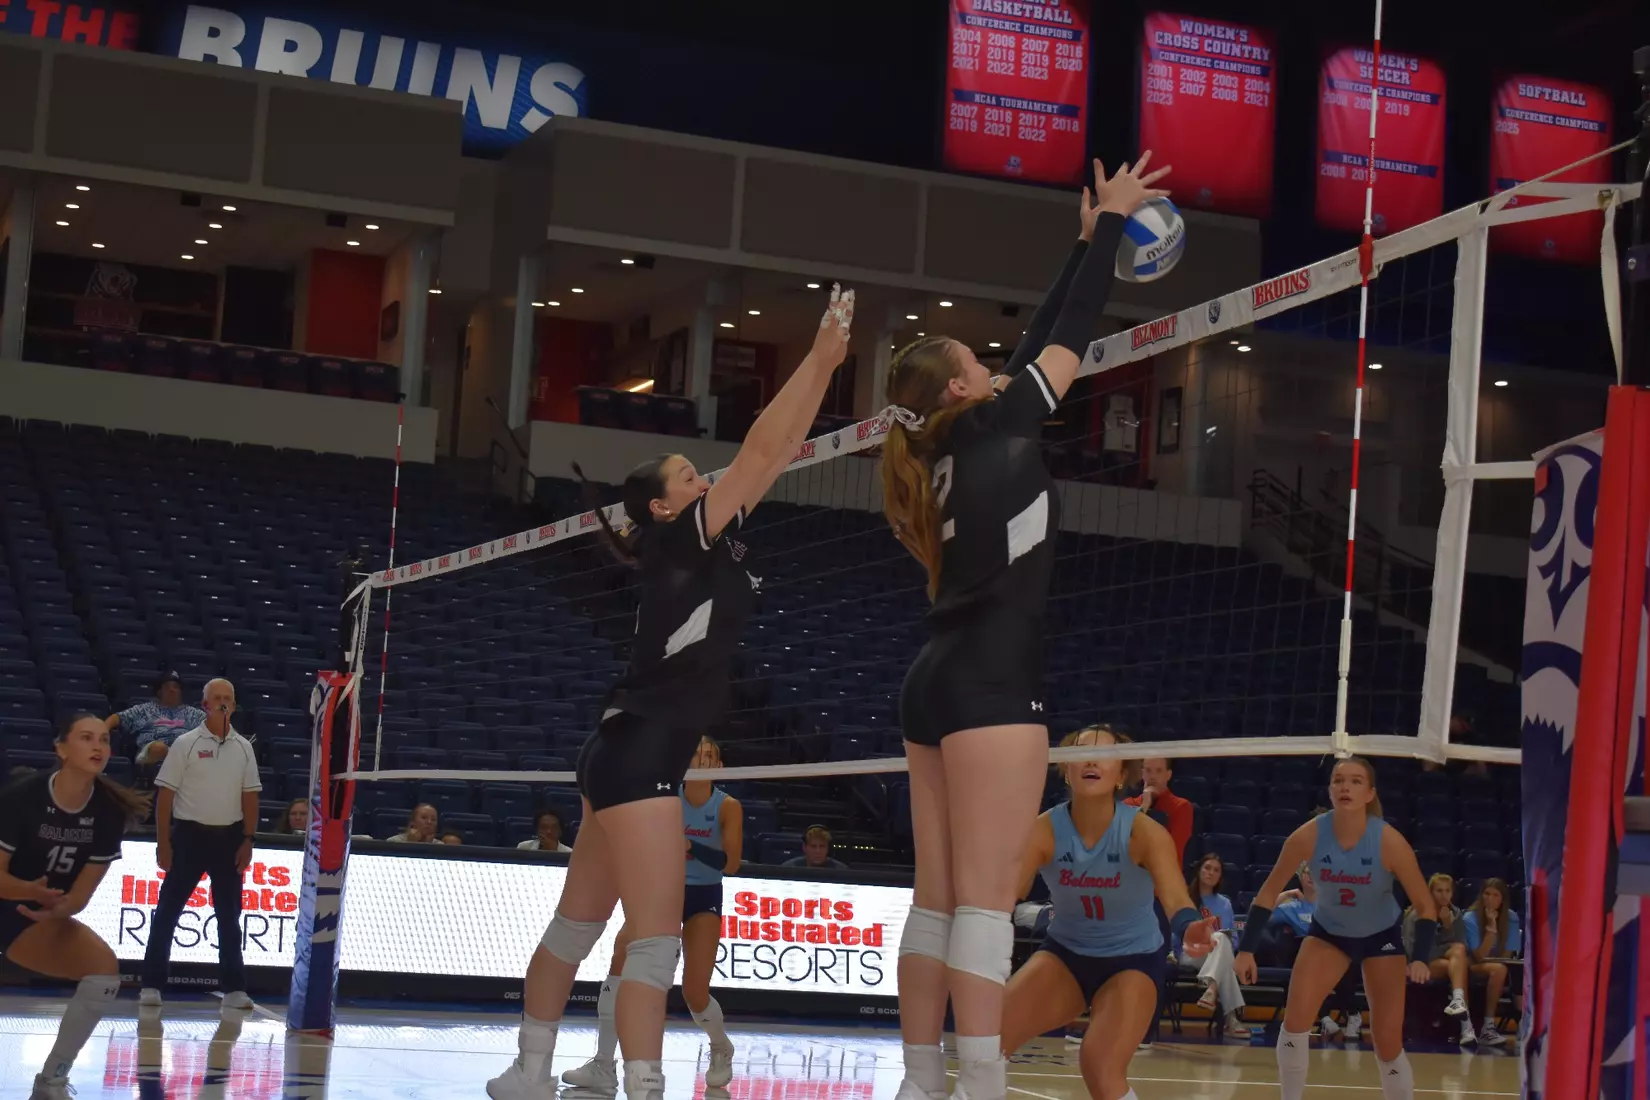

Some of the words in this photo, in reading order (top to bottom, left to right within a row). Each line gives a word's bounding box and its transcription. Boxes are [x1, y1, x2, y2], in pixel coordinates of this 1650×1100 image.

[973, 0, 1072, 24] BASKETBALL
[966, 15, 1021, 32] CONFERENCE
[1024, 24, 1073, 40] CHAMPIONS
[1180, 20, 1248, 42] WOMEN'S
[953, 28, 981, 43] 2004
[1022, 38, 1050, 52] 2007
[1155, 31, 1200, 50] CROSS
[1204, 40, 1270, 60] COUNTRY
[26, 0, 139, 50] THE
[178, 4, 586, 133] BRUINS
[953, 42, 980, 56] 2017
[1021, 52, 1049, 66] 2019
[1055, 58, 1083, 72] 2020
[953, 56, 979, 70] 2021
[987, 61, 1014, 76] 2022
[1021, 66, 1048, 80] 2023
[1160, 51, 1212, 68] CONFERENCE
[1214, 60, 1261, 75] CHAMPIONS
[1148, 63, 1172, 78] 2001
[1180, 68, 1206, 83] 2002
[974, 94, 996, 104] NCAA
[1000, 98, 1060, 113] TOURNAMENT
[1180, 82, 1206, 96] 2007
[1244, 92, 1268, 106] 2021
[1333, 80, 1384, 96] CONFERENE
[1386, 88, 1431, 103] CHAMPIONS
[1518, 84, 1586, 106] SOFTBALL
[951, 103, 978, 118] 2007
[1018, 113, 1046, 128] 2017
[1506, 109, 1554, 124] CONFERENCE
[1556, 116, 1598, 130] CHAMPIONS
[984, 123, 1010, 137] 2021
[1018, 128, 1046, 142] 2022
[1342, 154, 1362, 166] NCAA
[1366, 158, 1418, 173] TURNAMENT
[1253, 269, 1310, 309] BRUINS
[1131, 315, 1177, 350] BELMONT
[46, 845, 78, 873] 15
[1059, 868, 1121, 888] Belmont
[1321, 868, 1372, 885] Belmont
[734, 891, 854, 921] Sports
[1080, 895, 1105, 921] 11
[1339, 888, 1357, 907] 2
[720, 915, 883, 947] llustrated
